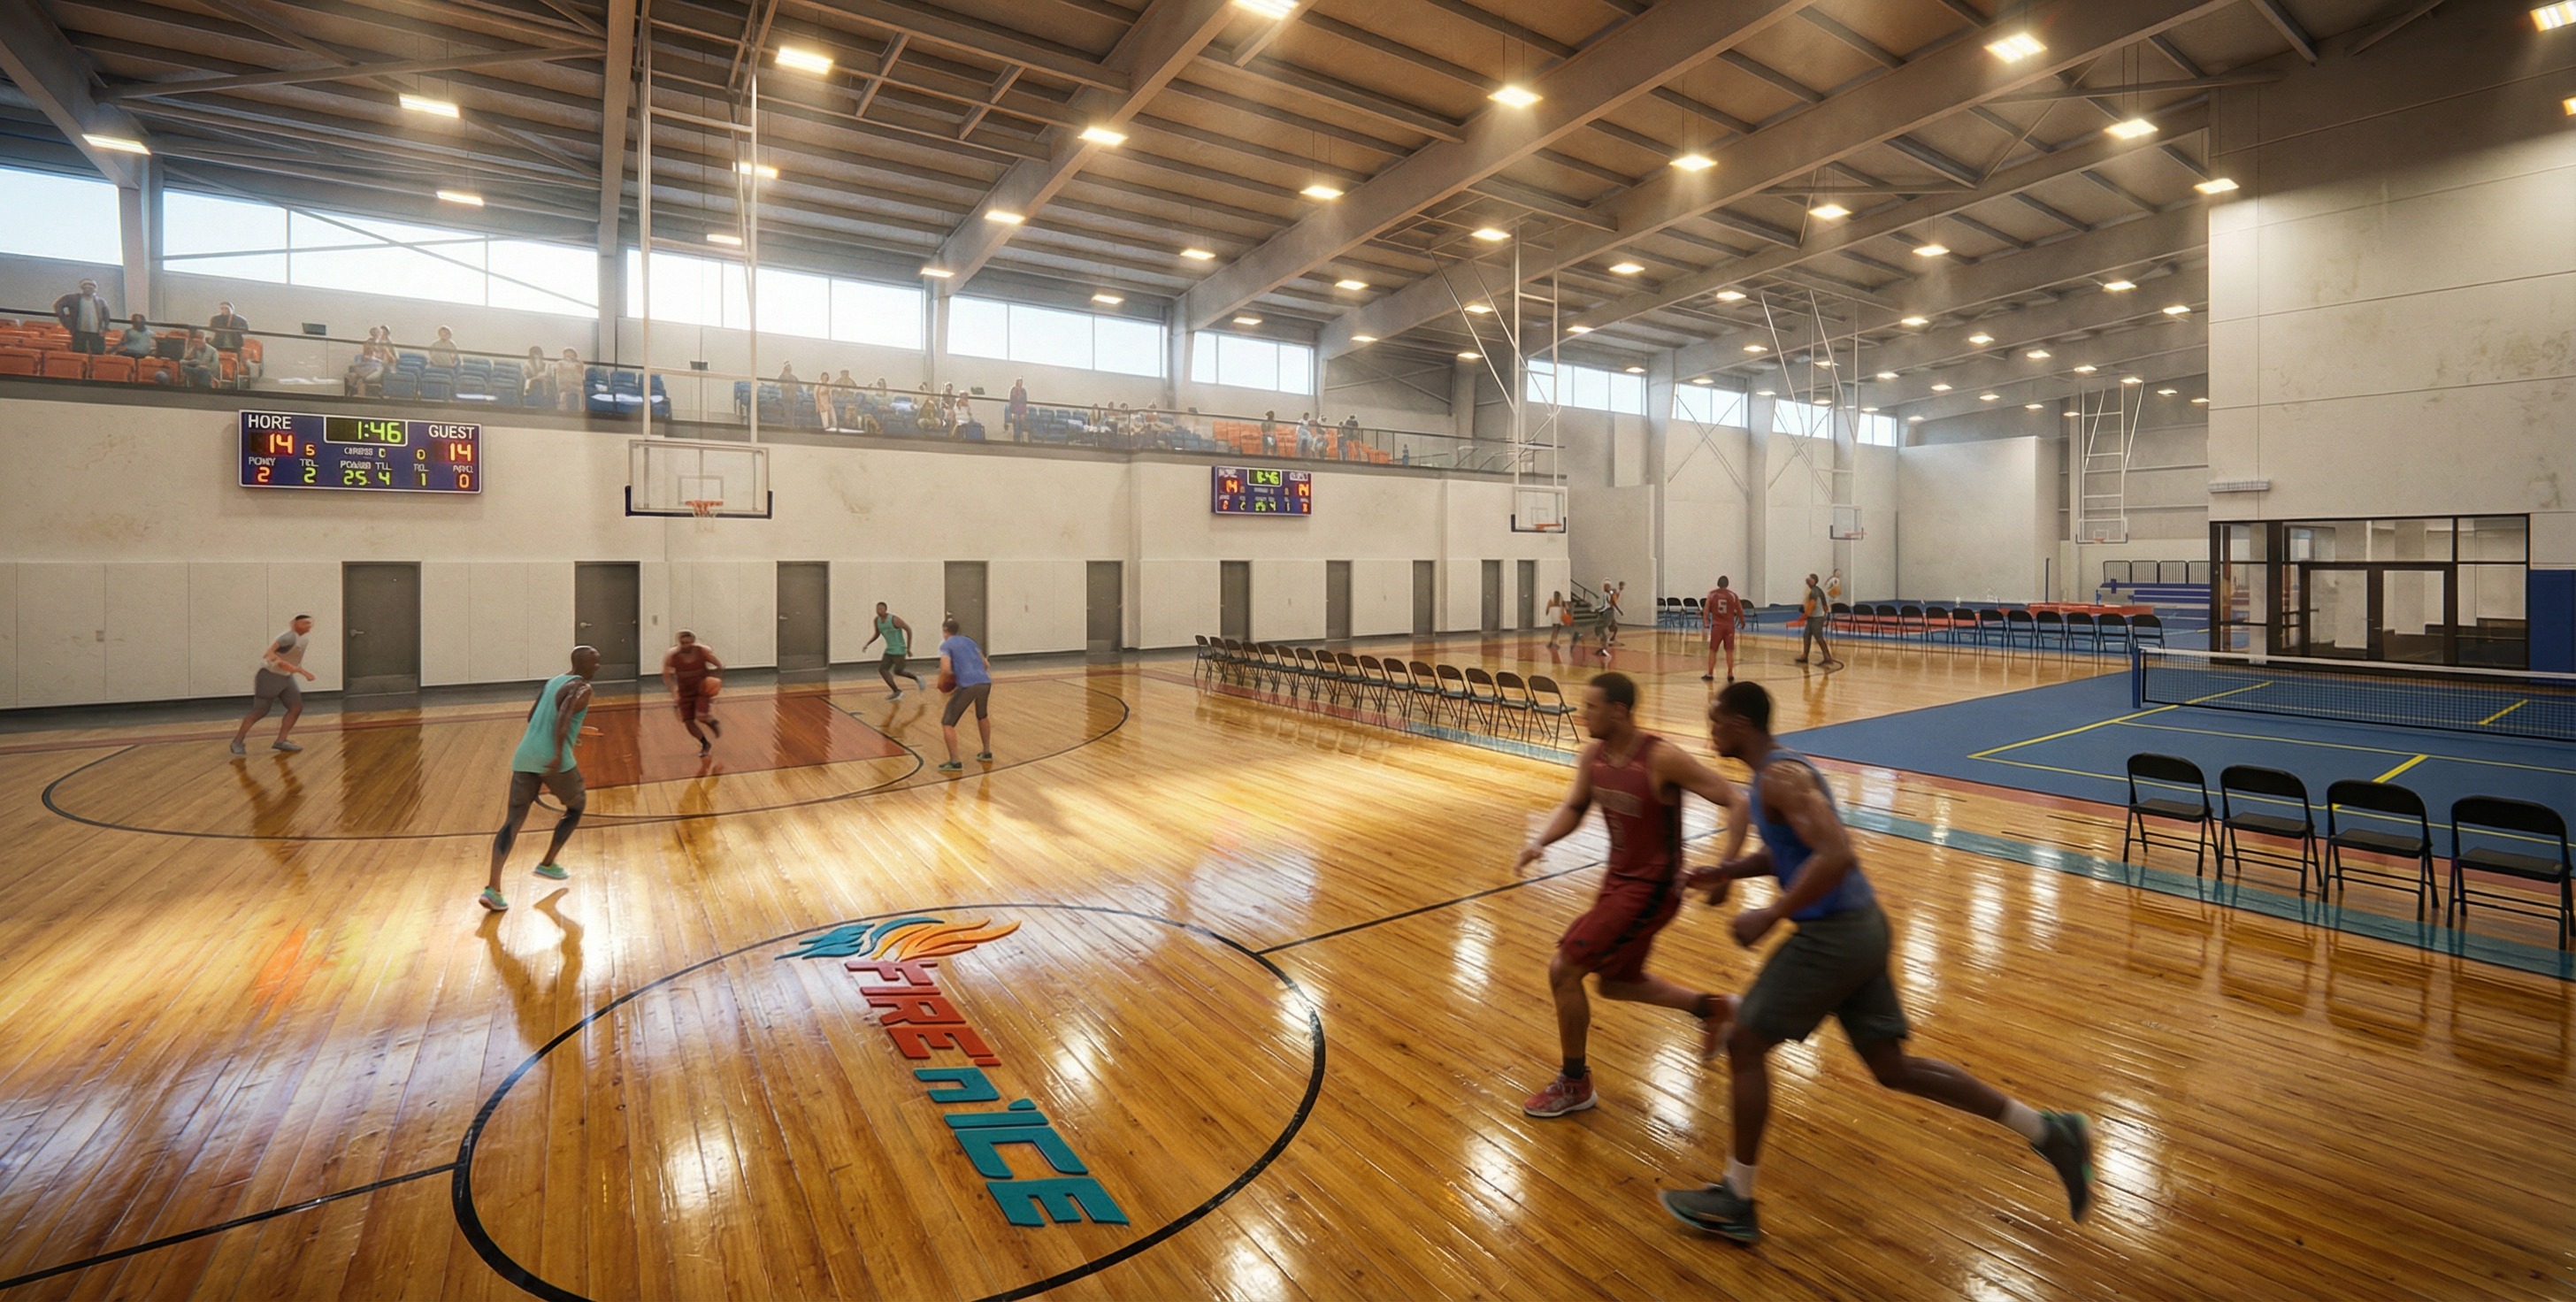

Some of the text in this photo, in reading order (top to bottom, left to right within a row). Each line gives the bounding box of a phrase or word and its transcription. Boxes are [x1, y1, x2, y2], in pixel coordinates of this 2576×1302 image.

[248, 414, 292, 430] HORE
[357, 420, 402, 443] 1:46
[428, 425, 475, 440] GUEST
[269, 433, 294, 455] 14
[449, 442, 472, 462] 14
[257, 466, 271, 483] 2
[303, 467, 317, 484] 2
[378, 471, 391, 486] 4
[420, 473, 427, 486] 1
[458, 473, 471, 488] 0
